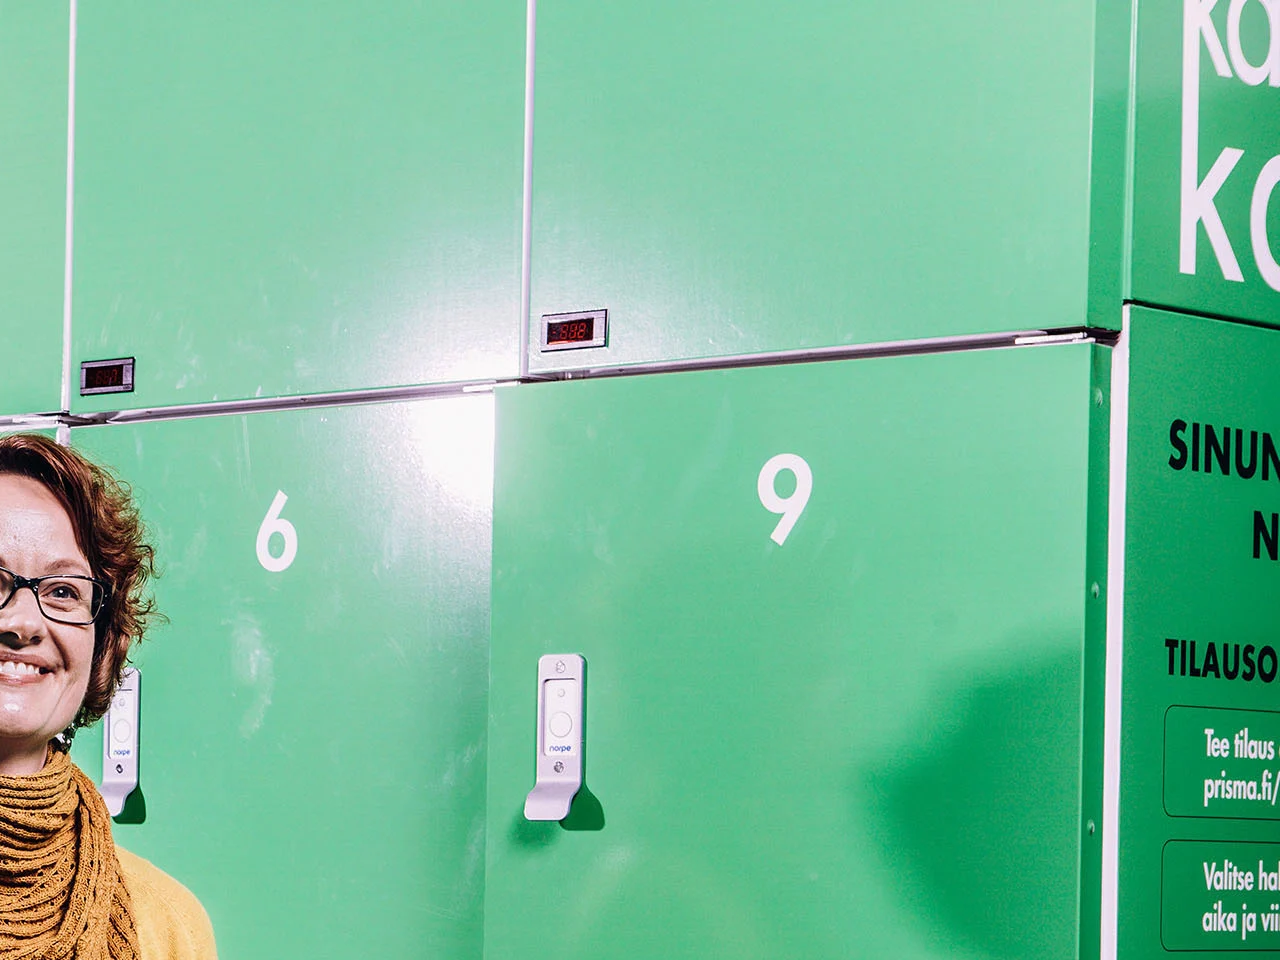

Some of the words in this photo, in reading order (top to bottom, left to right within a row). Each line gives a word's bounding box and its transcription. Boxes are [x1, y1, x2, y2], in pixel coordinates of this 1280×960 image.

[1168, 418, 1280, 482] SINUN
[757, 453, 813, 546] 9
[255, 489, 298, 572] 6
[1165, 638, 1278, 683] TILAUSO
[549, 745, 571, 753] norpe
[1204, 728, 1230, 758] Tee
[1234, 727, 1275, 760] tilaus
[1203, 859, 1254, 891] Valitse
[1202, 900, 1237, 932] aika
[1241, 903, 1257, 940] ja
